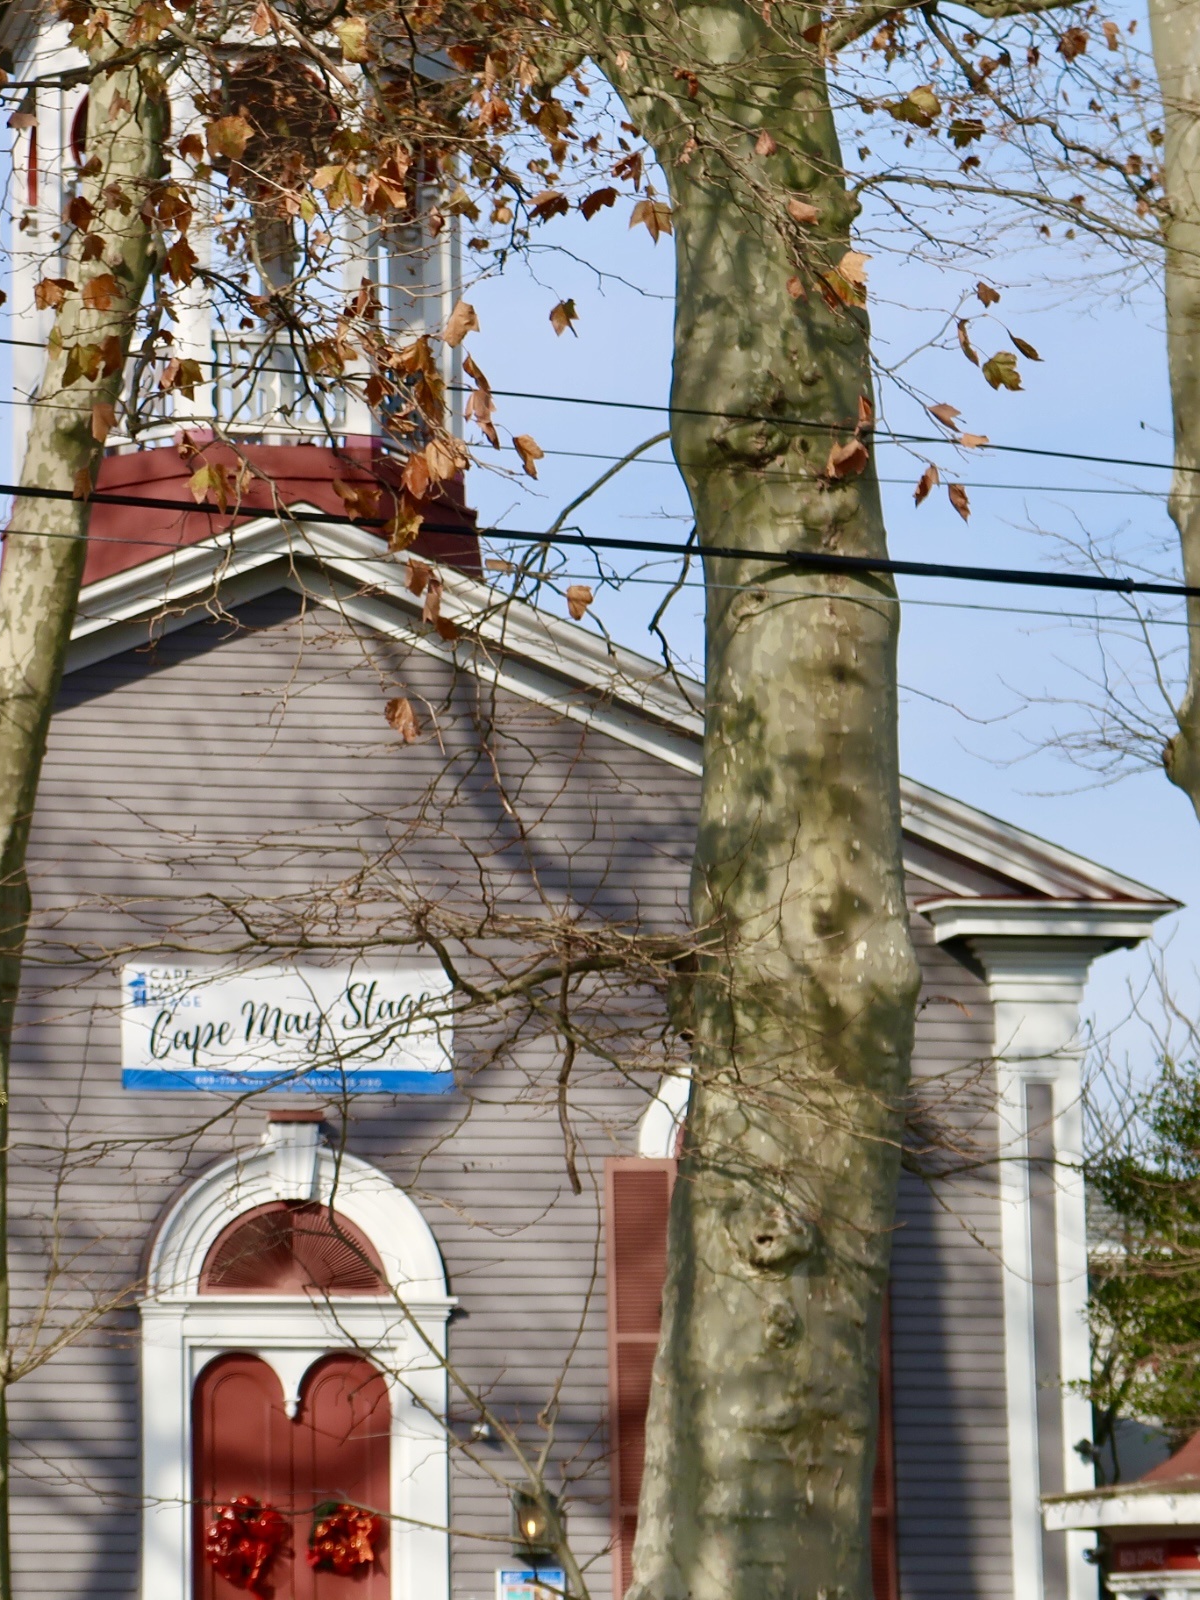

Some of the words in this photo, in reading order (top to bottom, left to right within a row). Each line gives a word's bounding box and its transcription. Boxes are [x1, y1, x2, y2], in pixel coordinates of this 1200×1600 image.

[150, 1010, 236, 1067] Cape
[241, 1000, 323, 1054] May
[341, 980, 434, 1034] Stage
